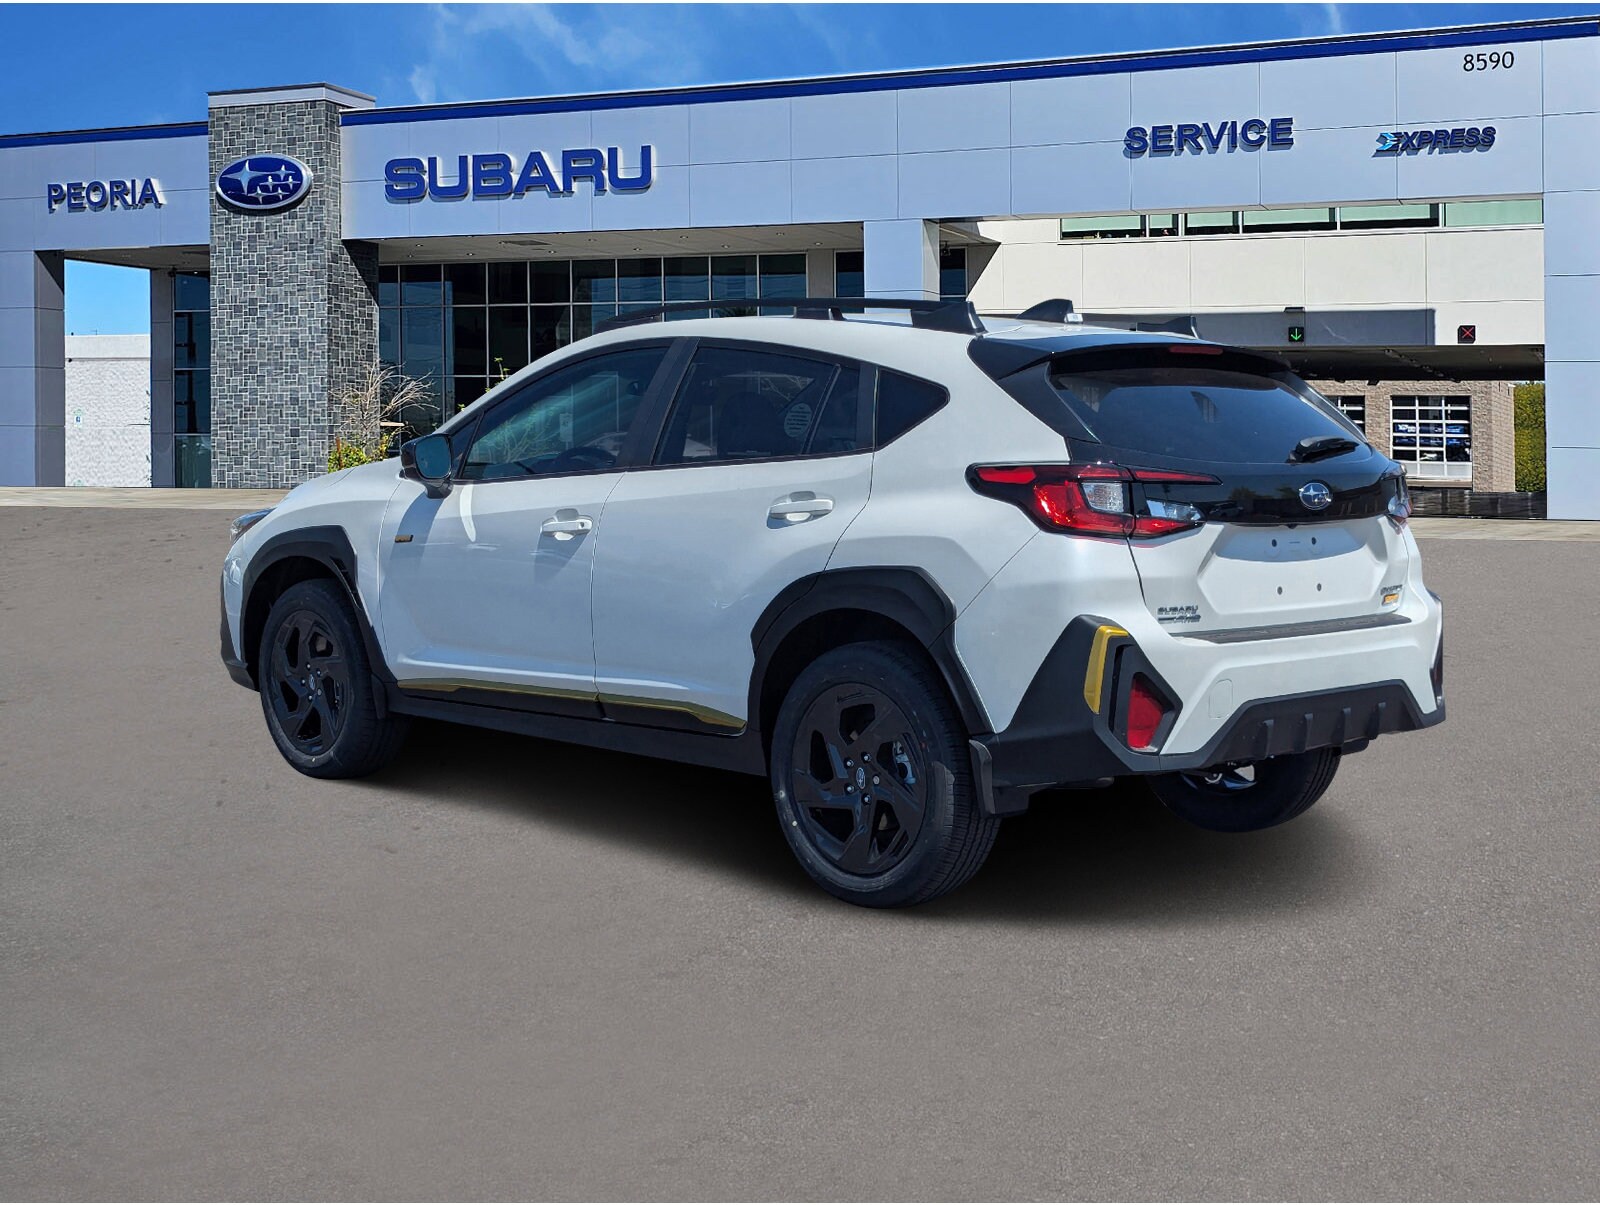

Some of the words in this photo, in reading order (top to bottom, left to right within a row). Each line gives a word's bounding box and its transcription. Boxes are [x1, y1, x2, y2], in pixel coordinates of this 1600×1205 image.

[1463, 51, 1514, 71] 8590
[1125, 117, 1294, 154] SERVICE
[1375, 126, 1497, 153] EXPRESS
[384, 145, 653, 202] SUBARU
[47, 178, 163, 212] PEORIA
